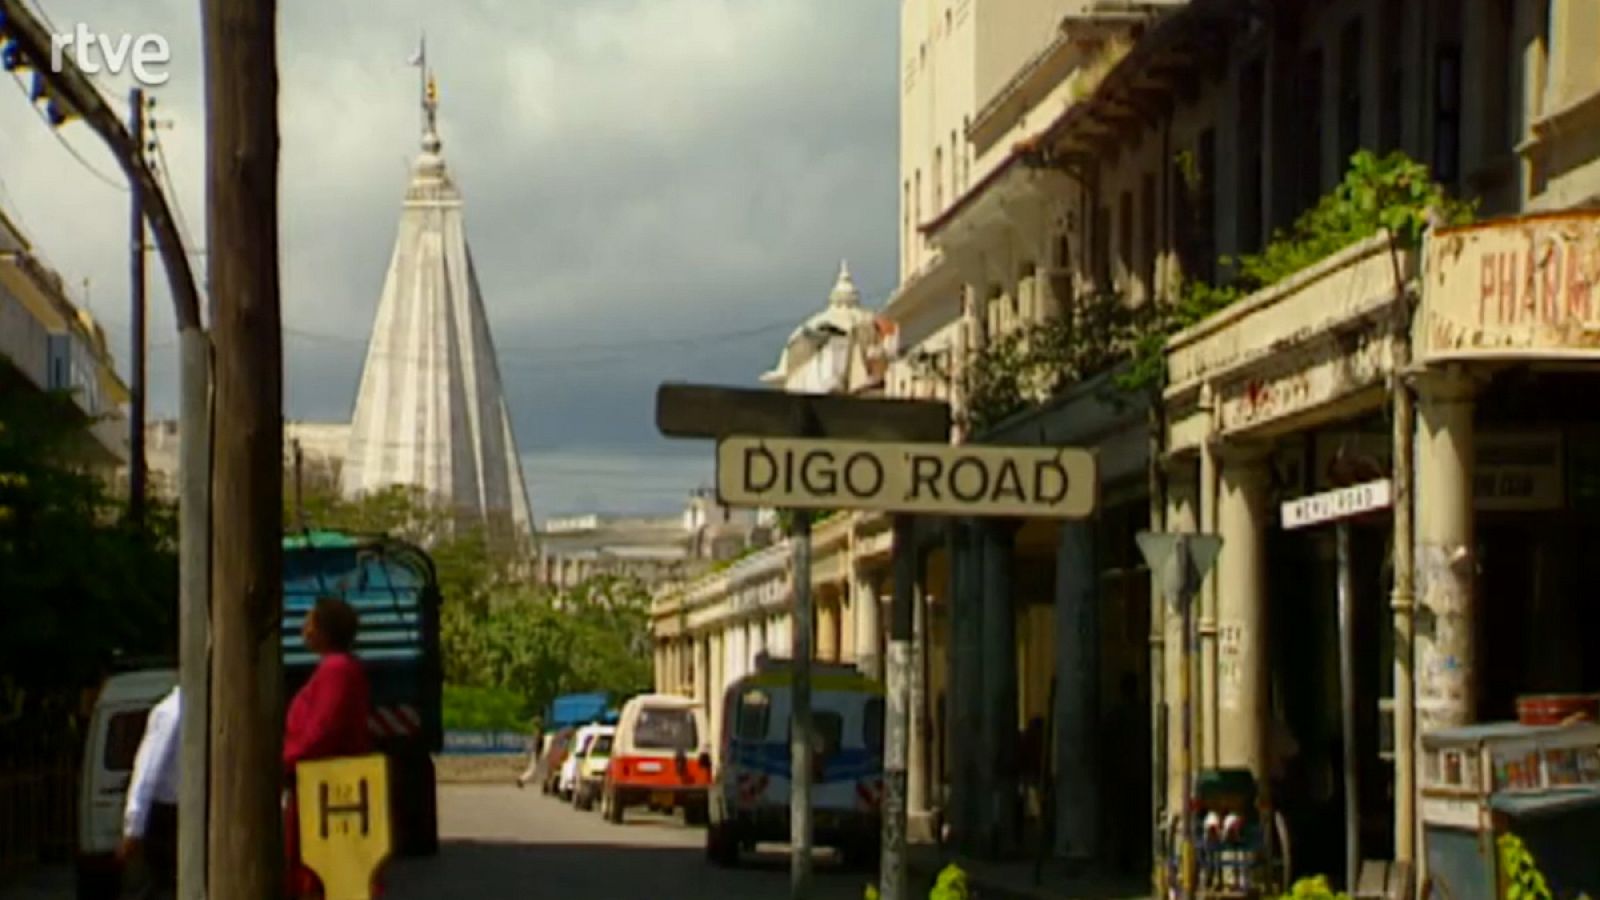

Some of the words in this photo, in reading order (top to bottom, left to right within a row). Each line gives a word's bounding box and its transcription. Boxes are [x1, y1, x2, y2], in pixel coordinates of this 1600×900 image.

[743, 441, 885, 498] DIGO
[908, 453, 1069, 505] ROAD
[319, 777, 369, 839] H
